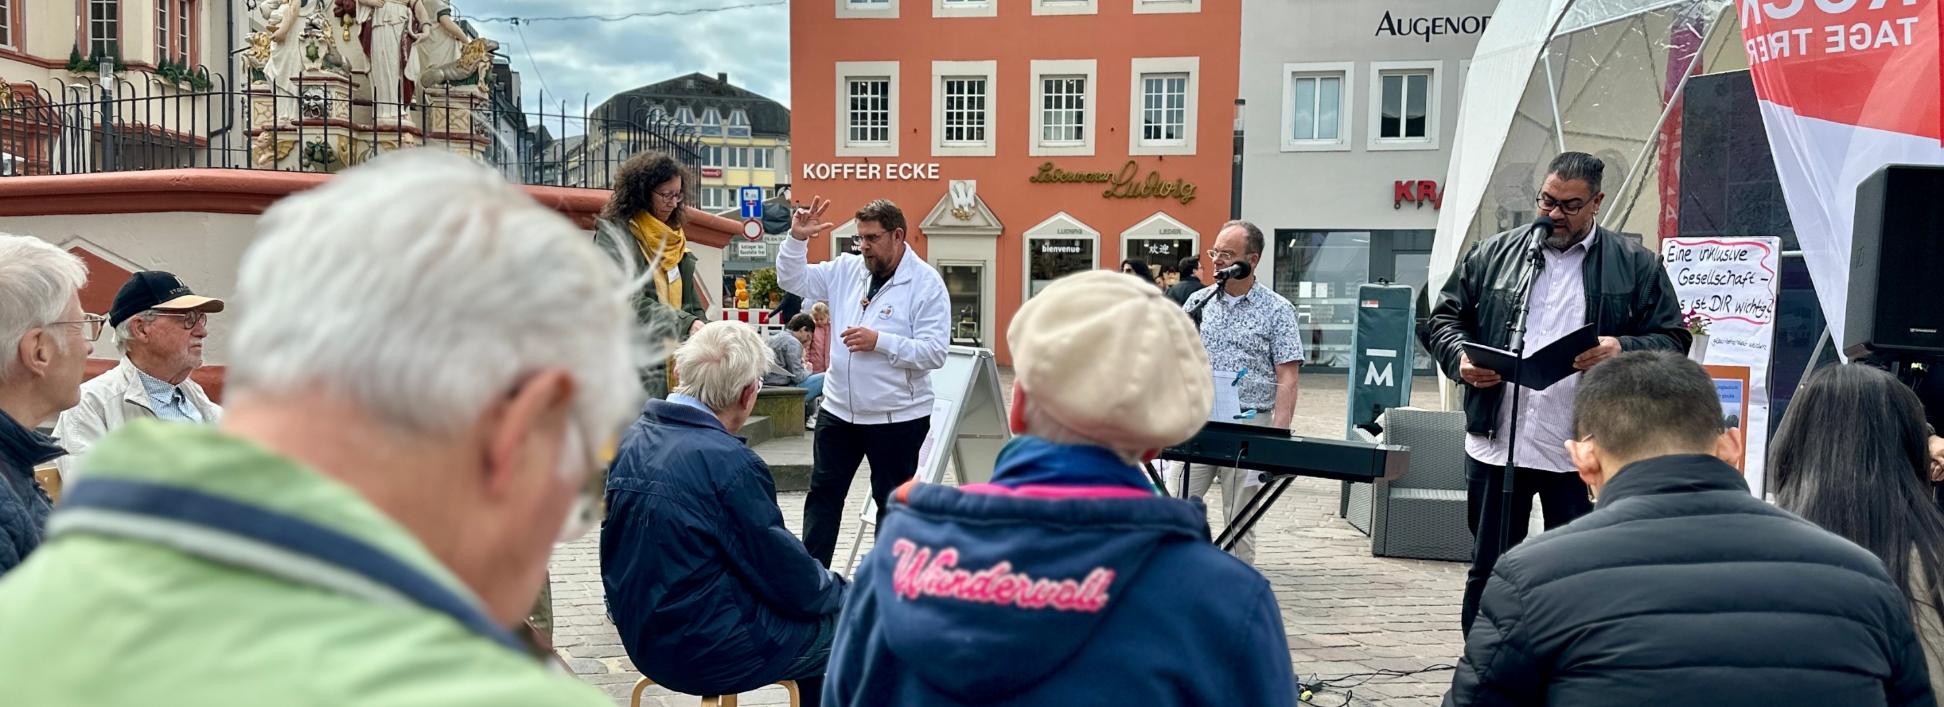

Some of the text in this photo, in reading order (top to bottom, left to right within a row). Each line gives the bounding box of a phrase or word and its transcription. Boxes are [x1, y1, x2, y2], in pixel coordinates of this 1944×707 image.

[803, 163, 940, 180] KOFFER ECKE
[1029, 160, 1198, 205] Lederwaren Ludwig
[1042, 244, 1081, 253] bienvenue
[1149, 243, 1170, 255] 欢迎
[1667, 246, 1748, 263] Eine inklusive
[1678, 268, 1756, 288] Gesellschaft
[1691, 299, 1707, 311] ist
[1709, 295, 1733, 313] DIR
[1735, 299, 1774, 319] wichtig?
[892, 537, 1116, 612] Wundervoll
